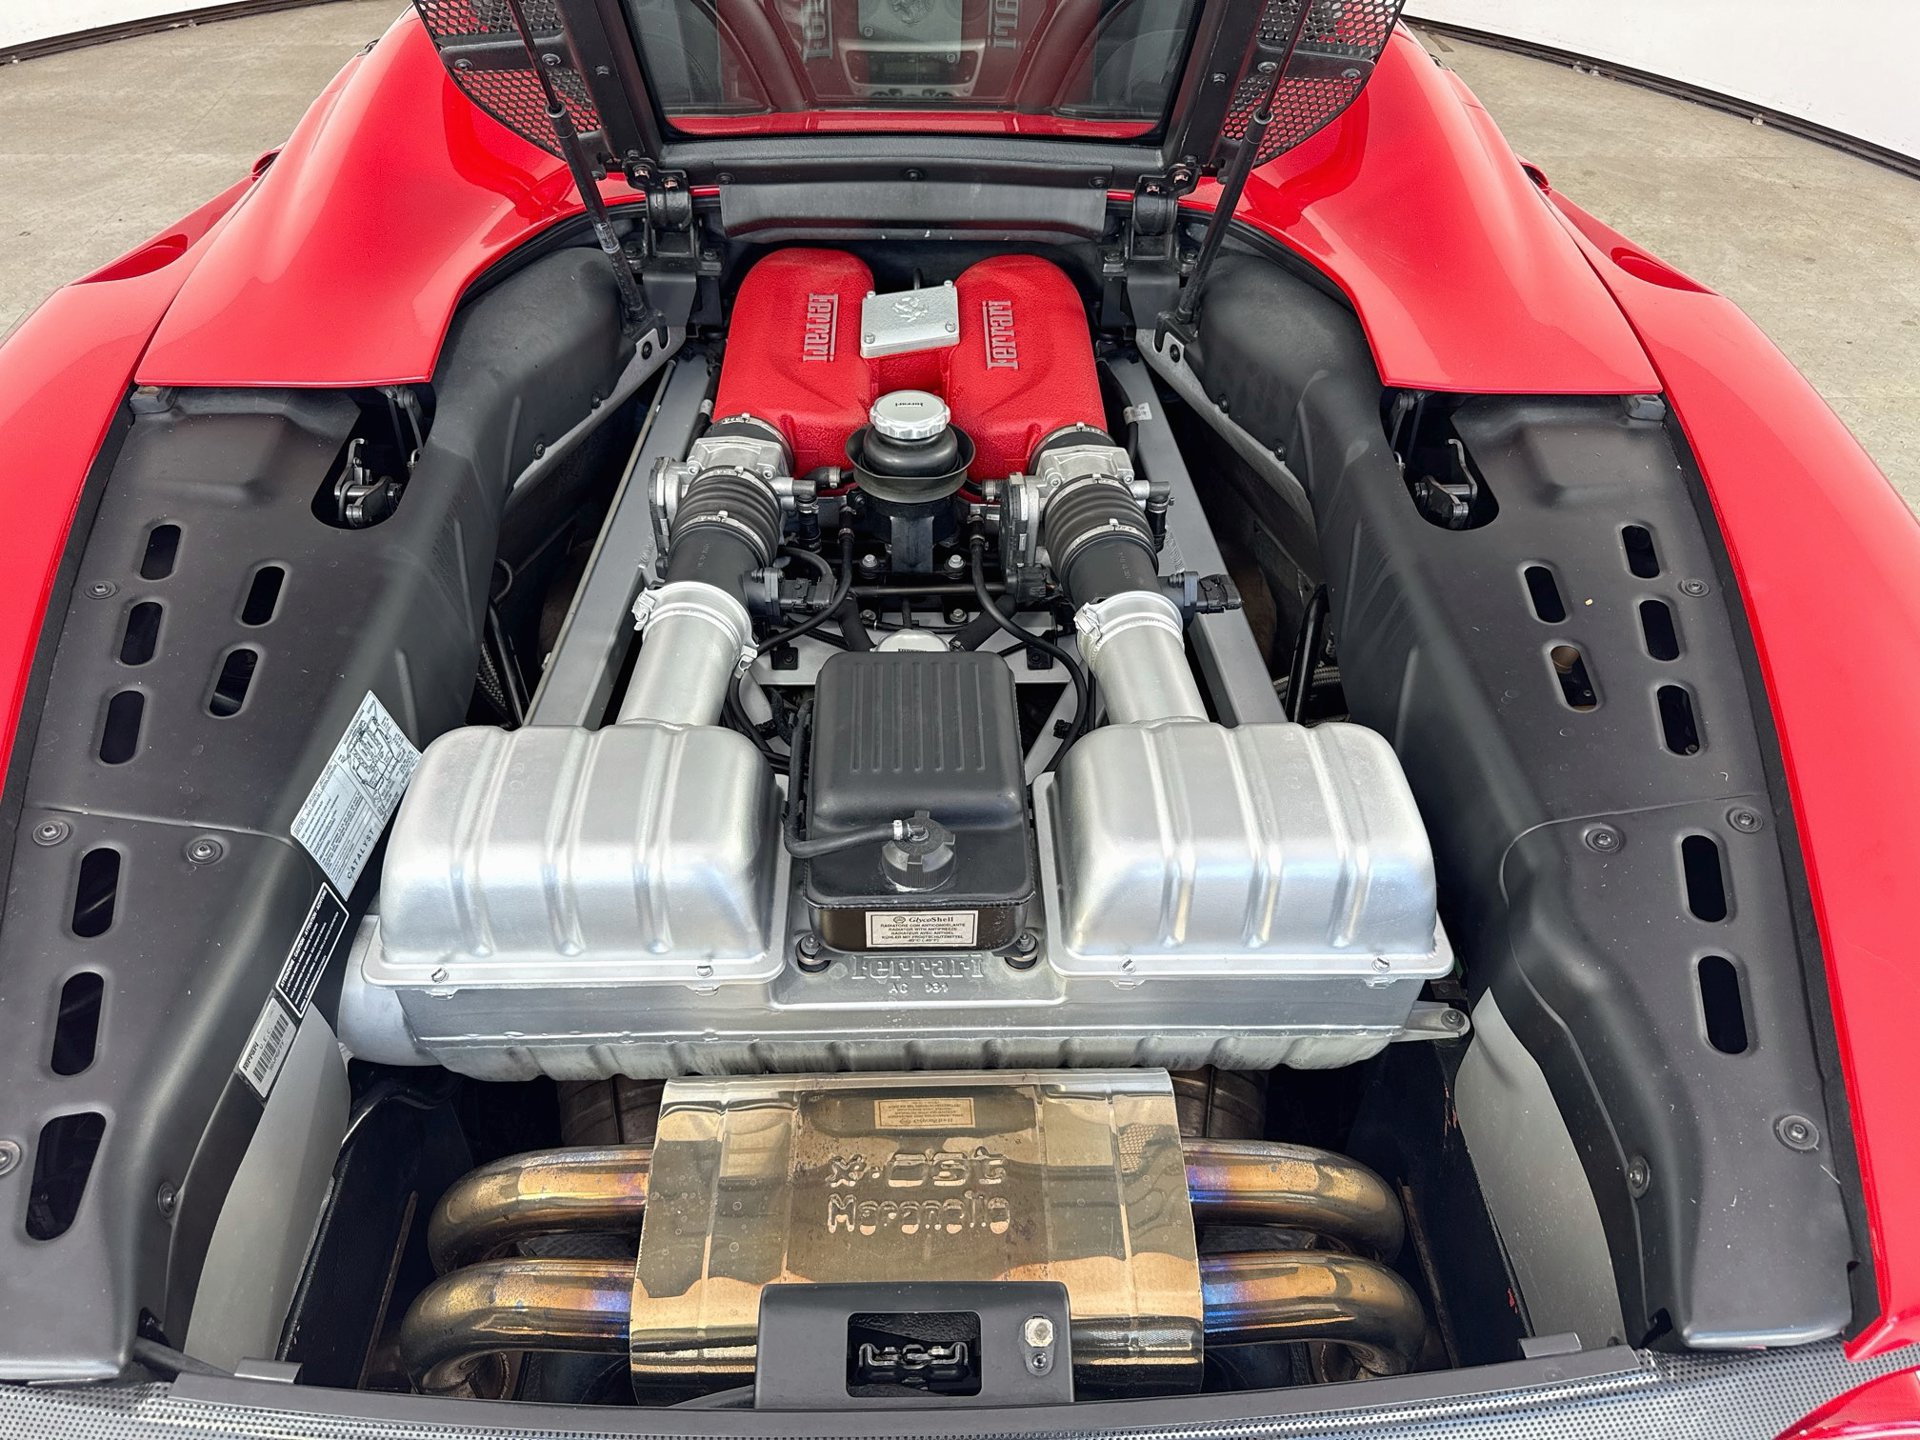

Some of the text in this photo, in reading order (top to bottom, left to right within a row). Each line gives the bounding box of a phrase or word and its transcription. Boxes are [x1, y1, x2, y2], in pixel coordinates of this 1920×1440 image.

[803, 293, 838, 362] Ferrari
[982, 300, 1019, 370] Ferrari
[346, 829, 376, 879] CATALYST
[293, 935, 305, 958] CAUTION
[303, 910, 317, 936] ATTENTION
[850, 954, 984, 980] Ferrari
[242, 1040, 259, 1071] Ferrari
[827, 1190, 1011, 1236] Maranello
